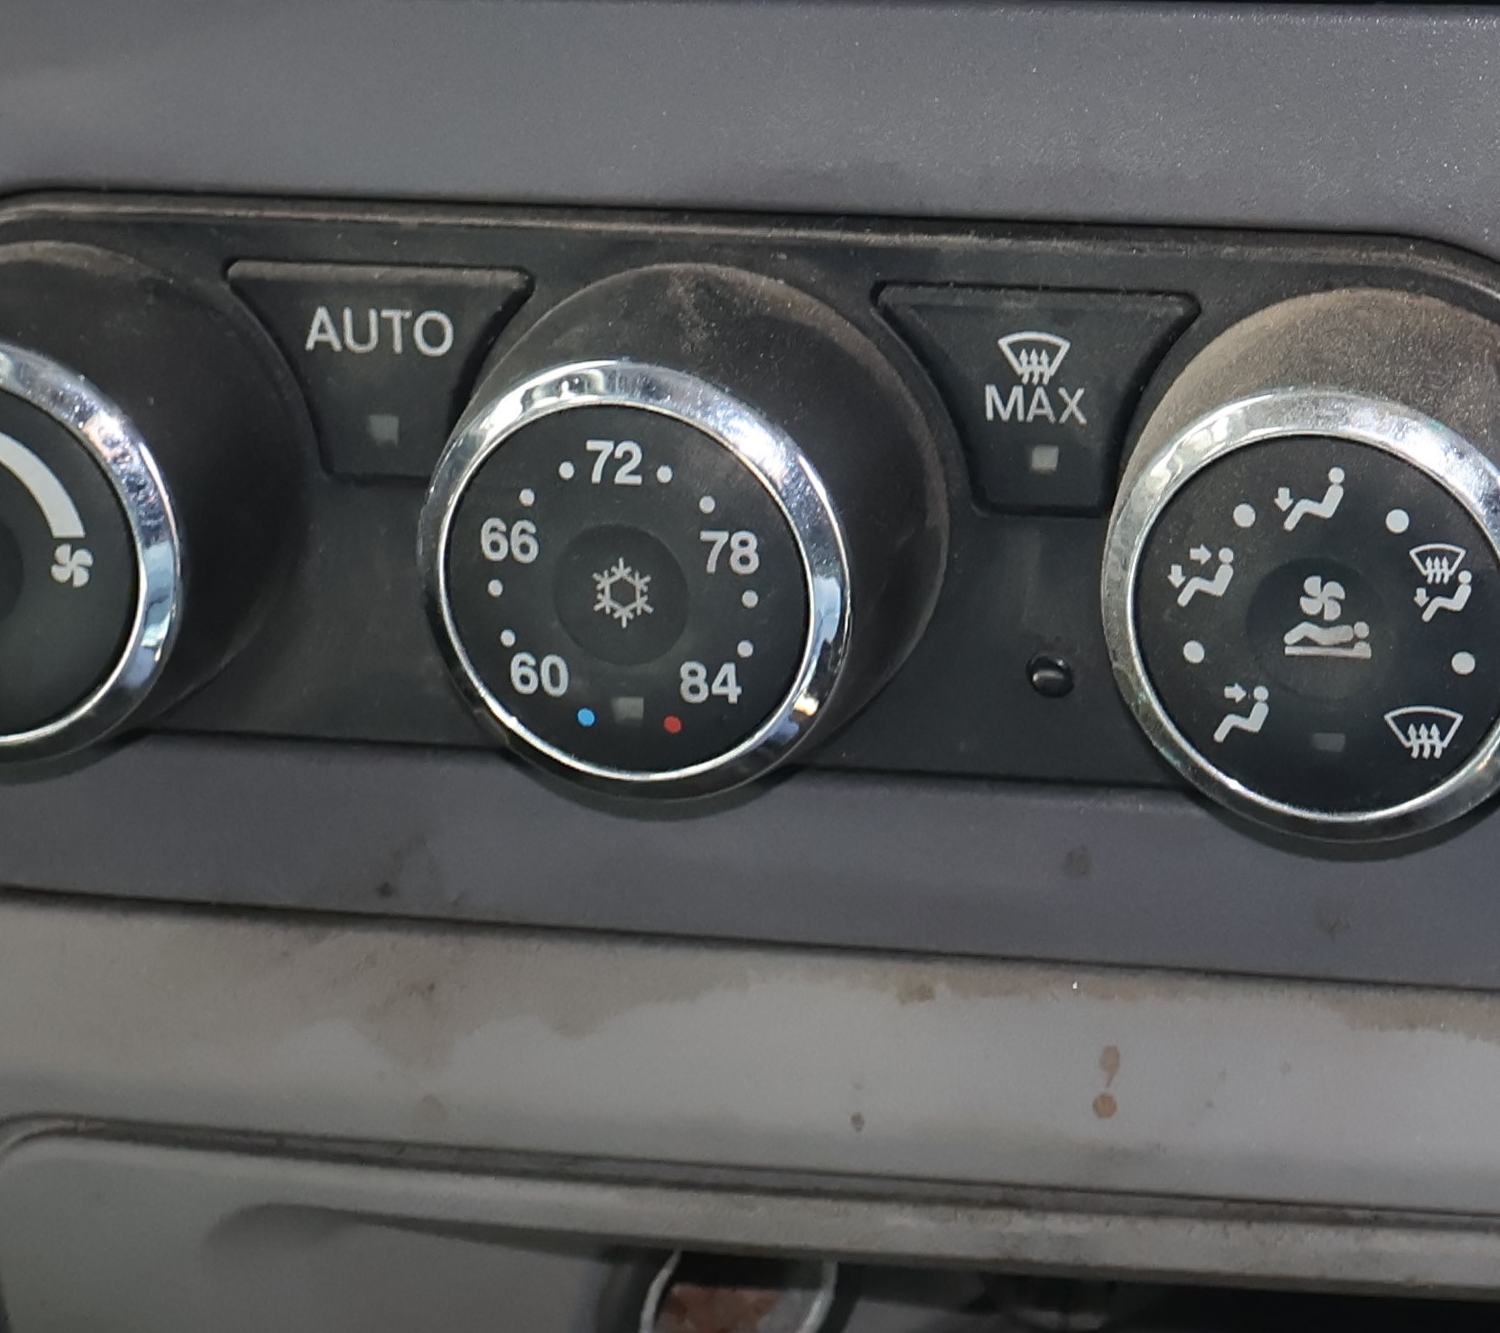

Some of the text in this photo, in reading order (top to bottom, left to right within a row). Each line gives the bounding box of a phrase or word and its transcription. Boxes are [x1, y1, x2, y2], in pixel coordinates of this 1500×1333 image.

[304, 305, 454, 357] AUTO
[984, 383, 1088, 427] MAX
[585, 439, 643, 486] 72
[479, 517, 540, 563] 66
[700, 530, 760, 575] 78
[508, 652, 569, 697] 60
[679, 661, 742, 705] 84
